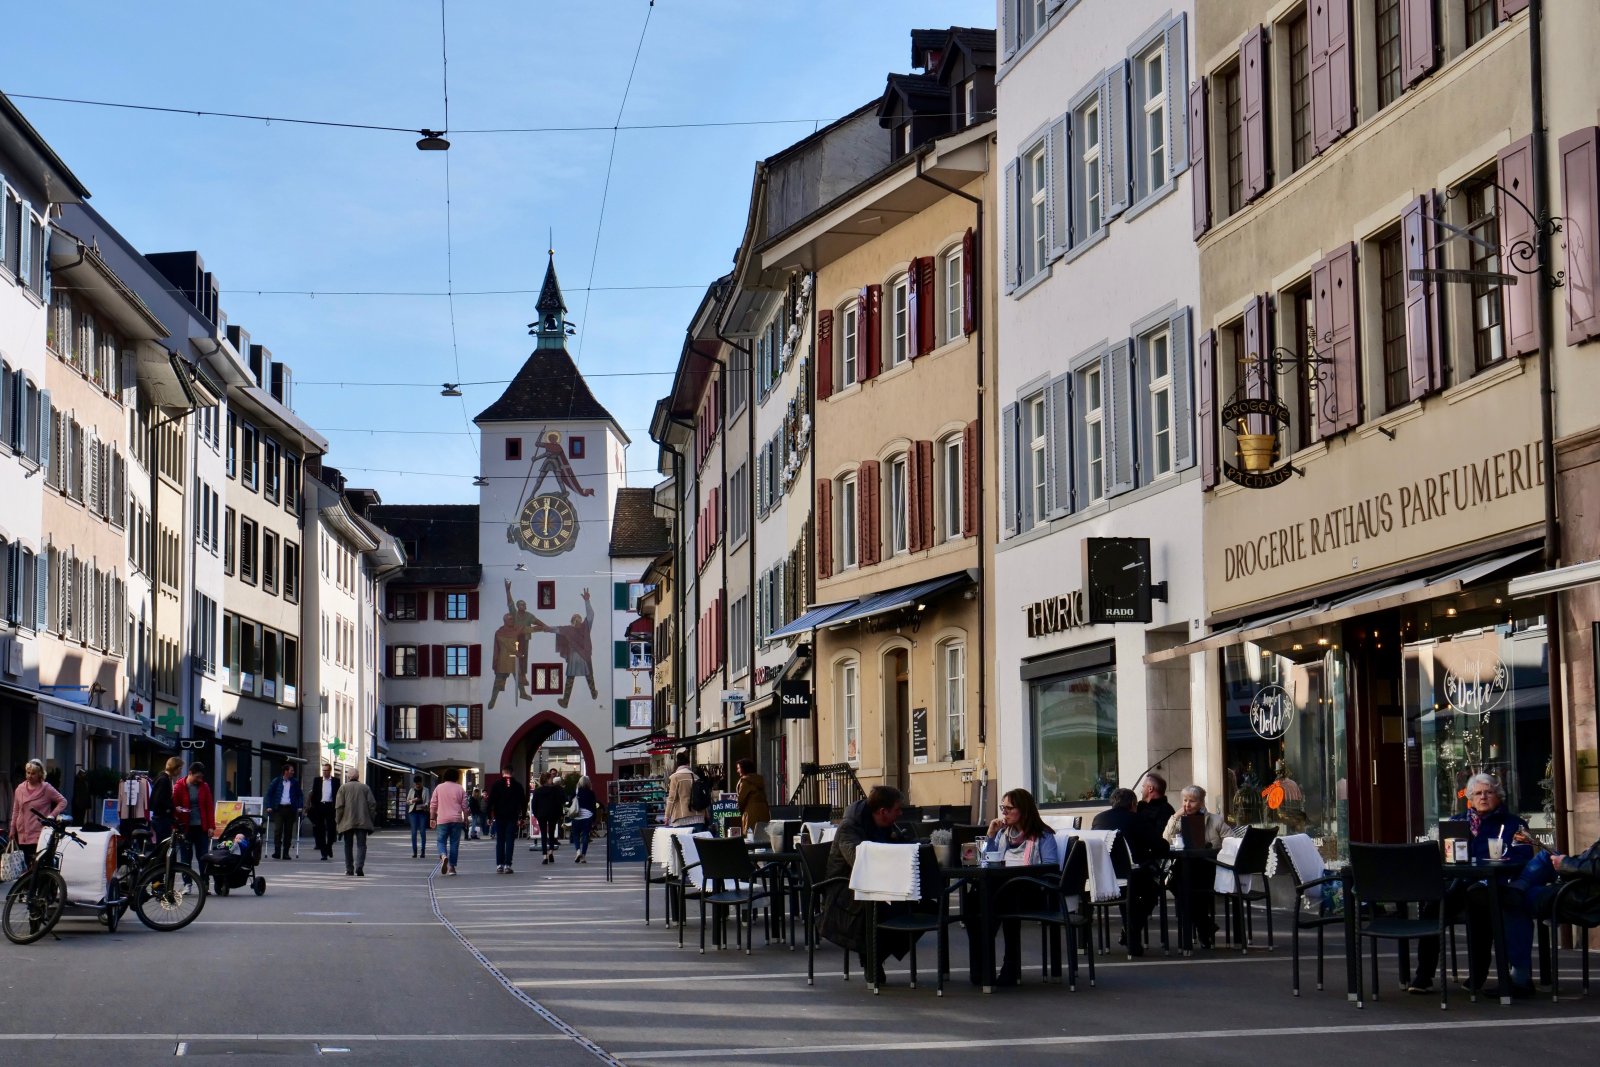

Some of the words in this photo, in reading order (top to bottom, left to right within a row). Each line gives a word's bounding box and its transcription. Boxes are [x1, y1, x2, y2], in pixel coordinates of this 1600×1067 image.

[1223, 400, 1288, 420] DROGERIE
[1227, 465, 1291, 486] RATHAUS
[1225, 522, 1307, 582] DROGERIE
[1309, 492, 1393, 555] RATHAUS
[1398, 439, 1545, 528] PARFUMERIE
[1105, 608, 1134, 616] RADO
[782, 694, 808, 705] Salt.
[1458, 672, 1495, 709] Dolce
[712, 803, 724, 811] DAS
